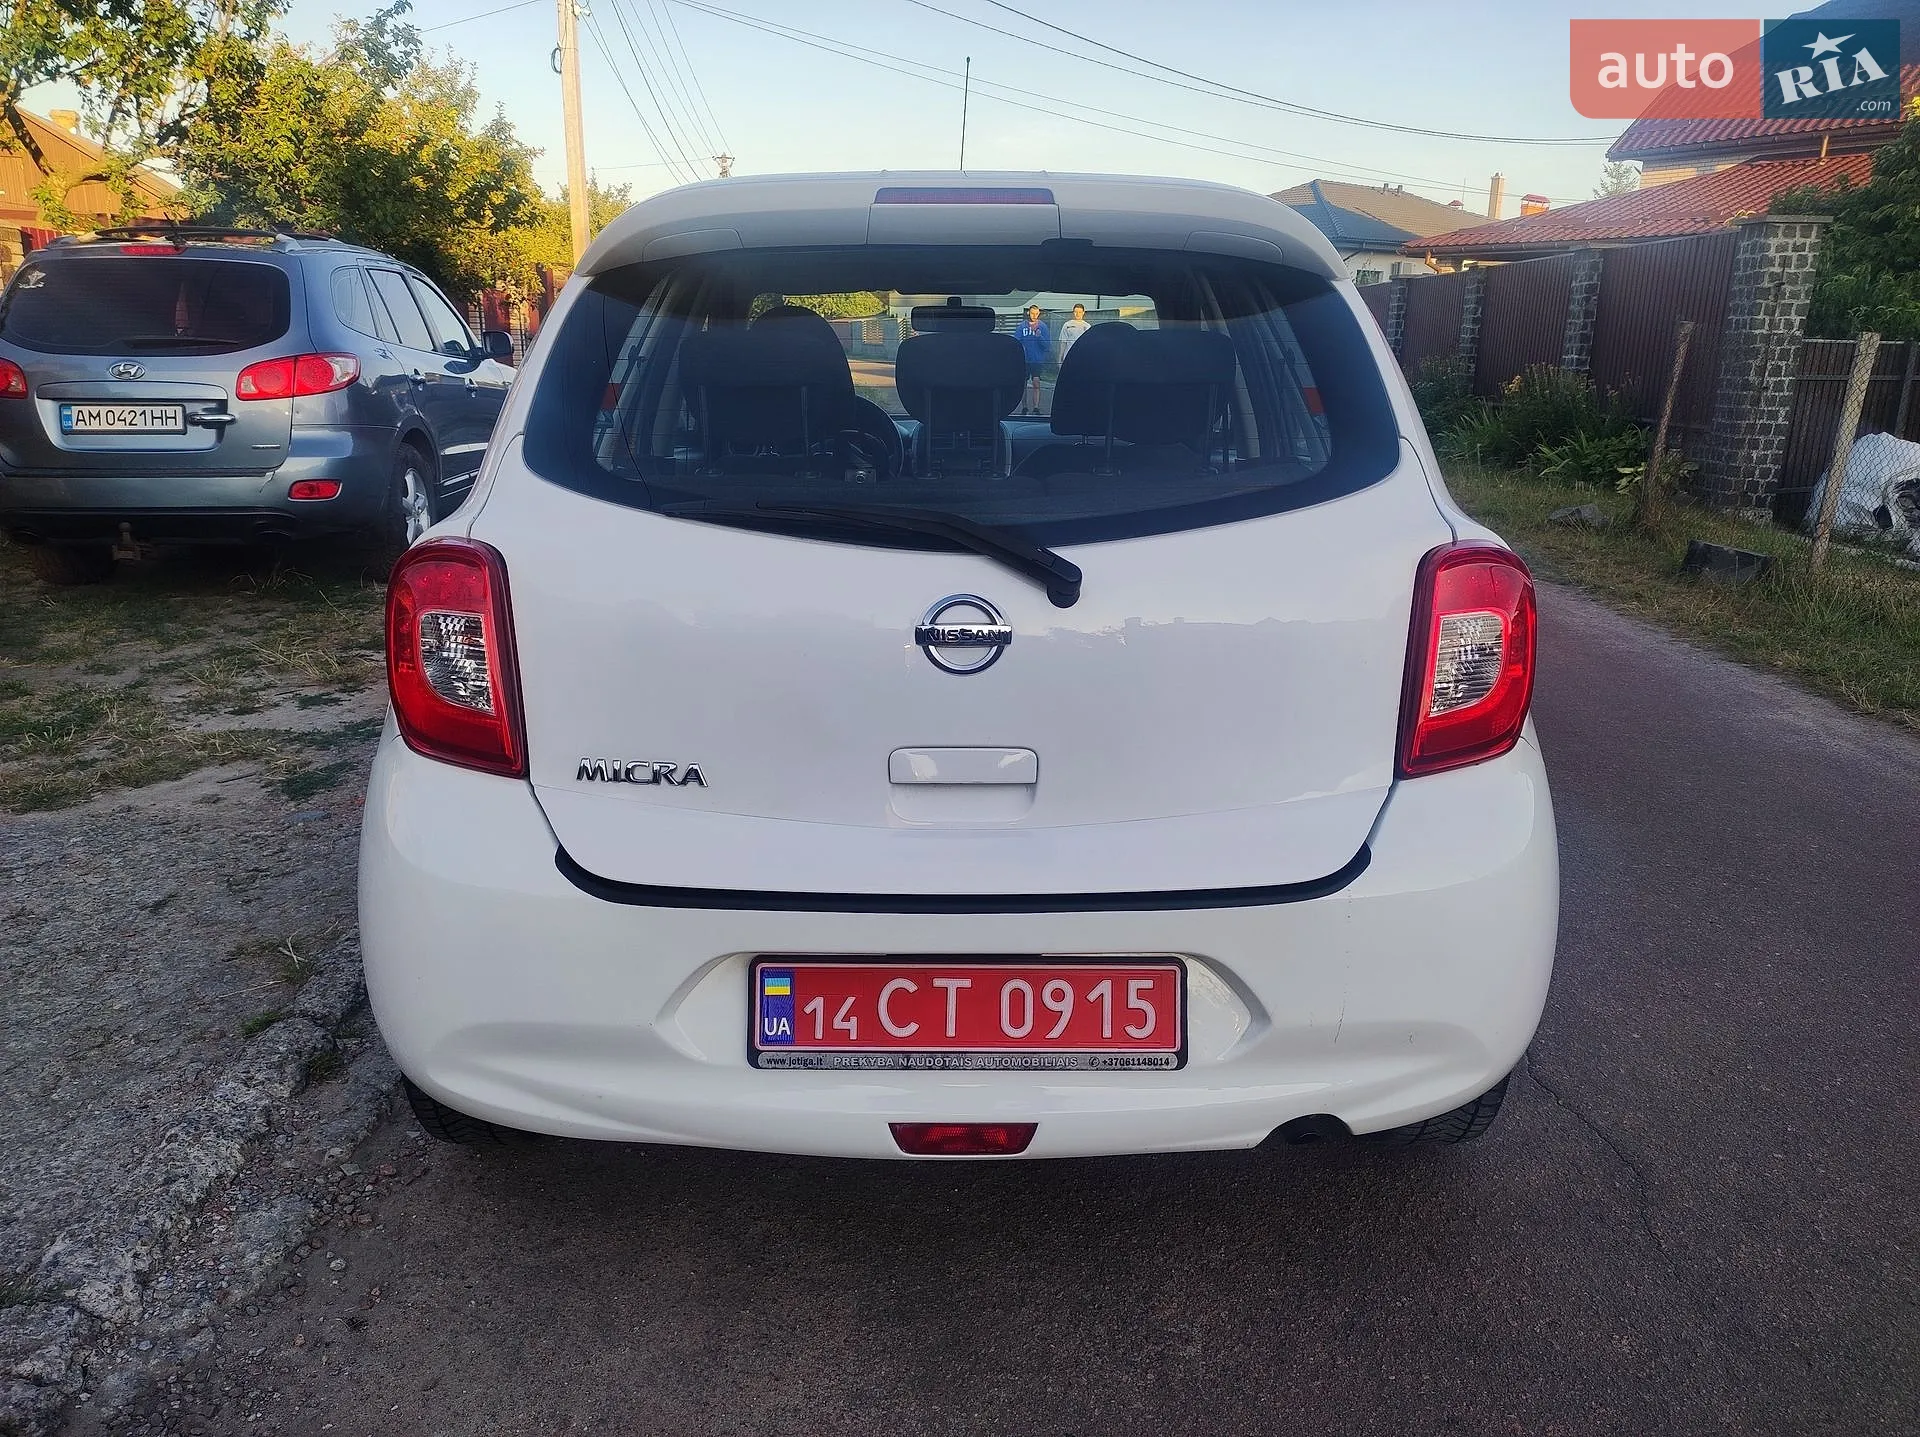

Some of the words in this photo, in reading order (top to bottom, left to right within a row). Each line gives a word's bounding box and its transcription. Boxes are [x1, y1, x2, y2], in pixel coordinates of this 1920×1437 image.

[925, 628, 1001, 643] NISSAN
[576, 757, 708, 788] MICRA
[802, 996, 858, 1041] 14
[877, 977, 972, 1038] CT
[1000, 979, 1158, 1039] 0915
[764, 1018, 791, 1036] UA
[833, 1057, 895, 1067] PREKYBA
[898, 1057, 972, 1067] NAUDOTAIS
[976, 1057, 1078, 1067] AUTOMOBILIAIS
[1101, 1058, 1170, 1067] +37061148014
